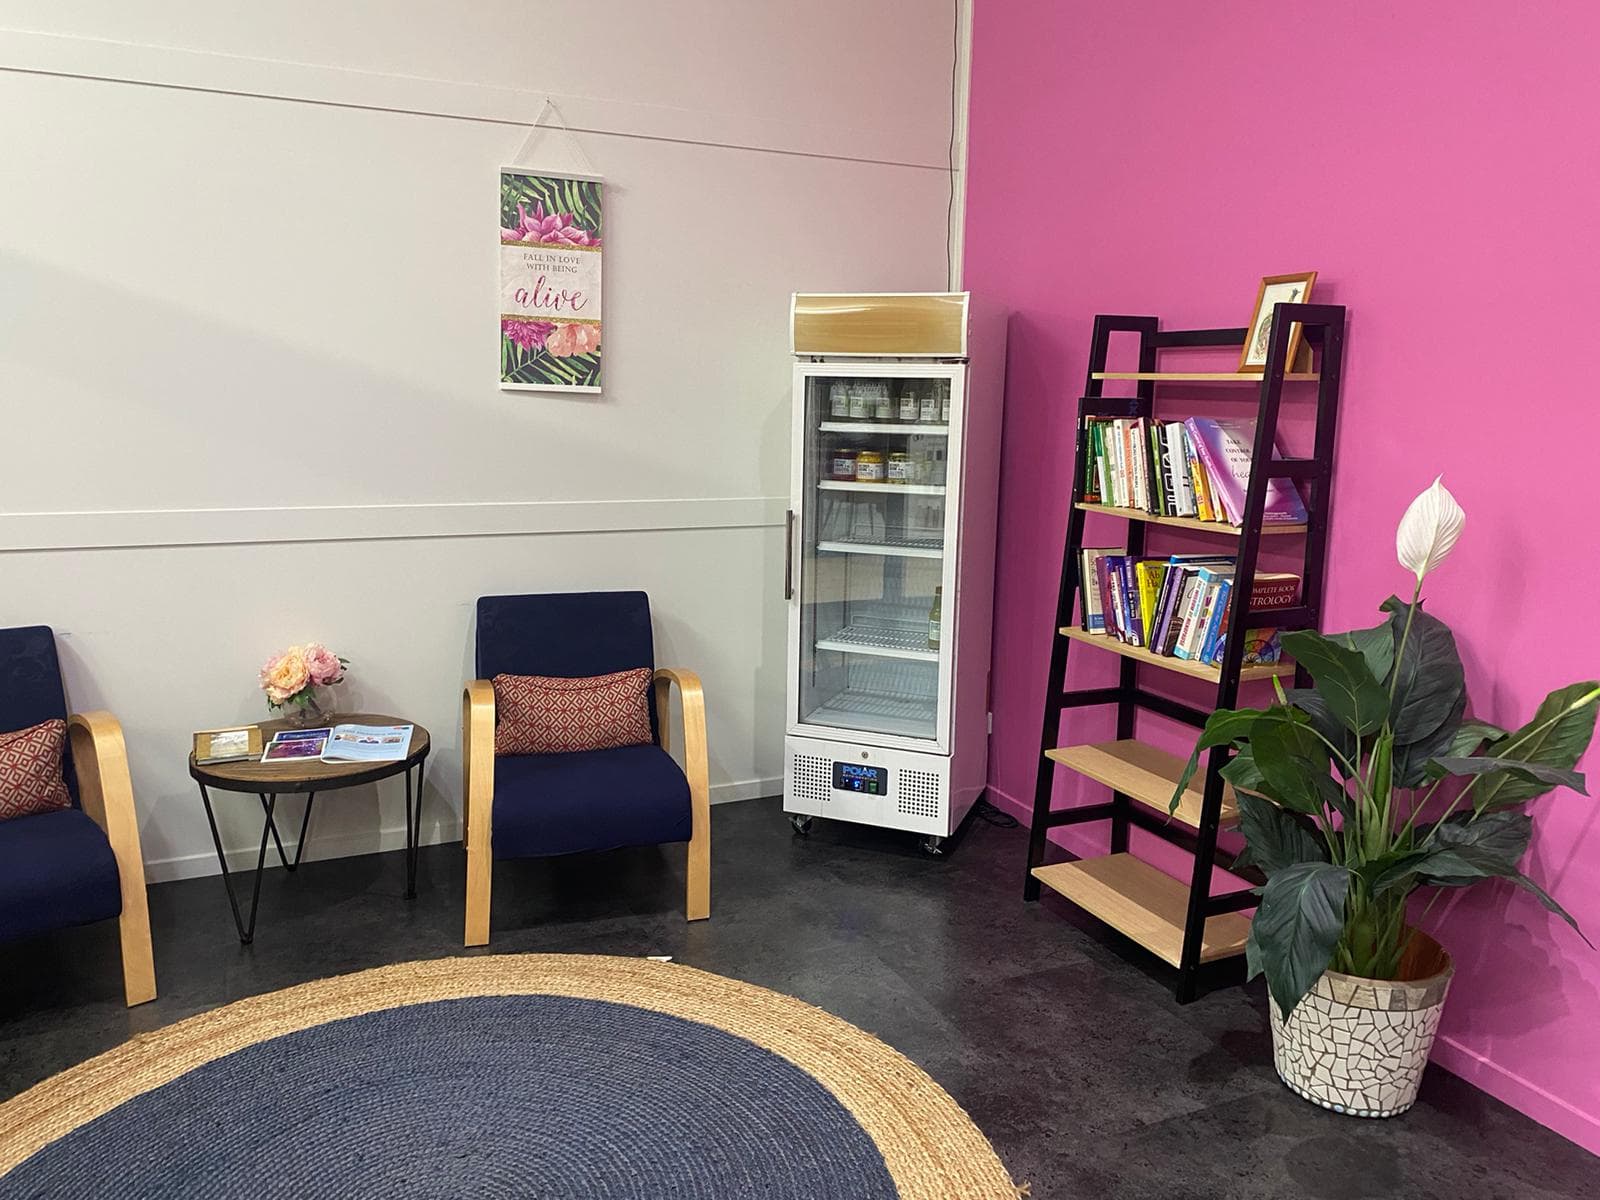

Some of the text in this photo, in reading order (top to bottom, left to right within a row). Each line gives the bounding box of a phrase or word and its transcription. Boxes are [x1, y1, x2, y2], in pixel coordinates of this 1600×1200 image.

[523, 253, 544, 262] FALL
[559, 256, 581, 265] LOVE
[526, 263, 578, 274] WITH BEING
[514, 275, 588, 312] alive
[1250, 594, 1294, 606] TROLOGY
[842, 765, 878, 778] POLAR
